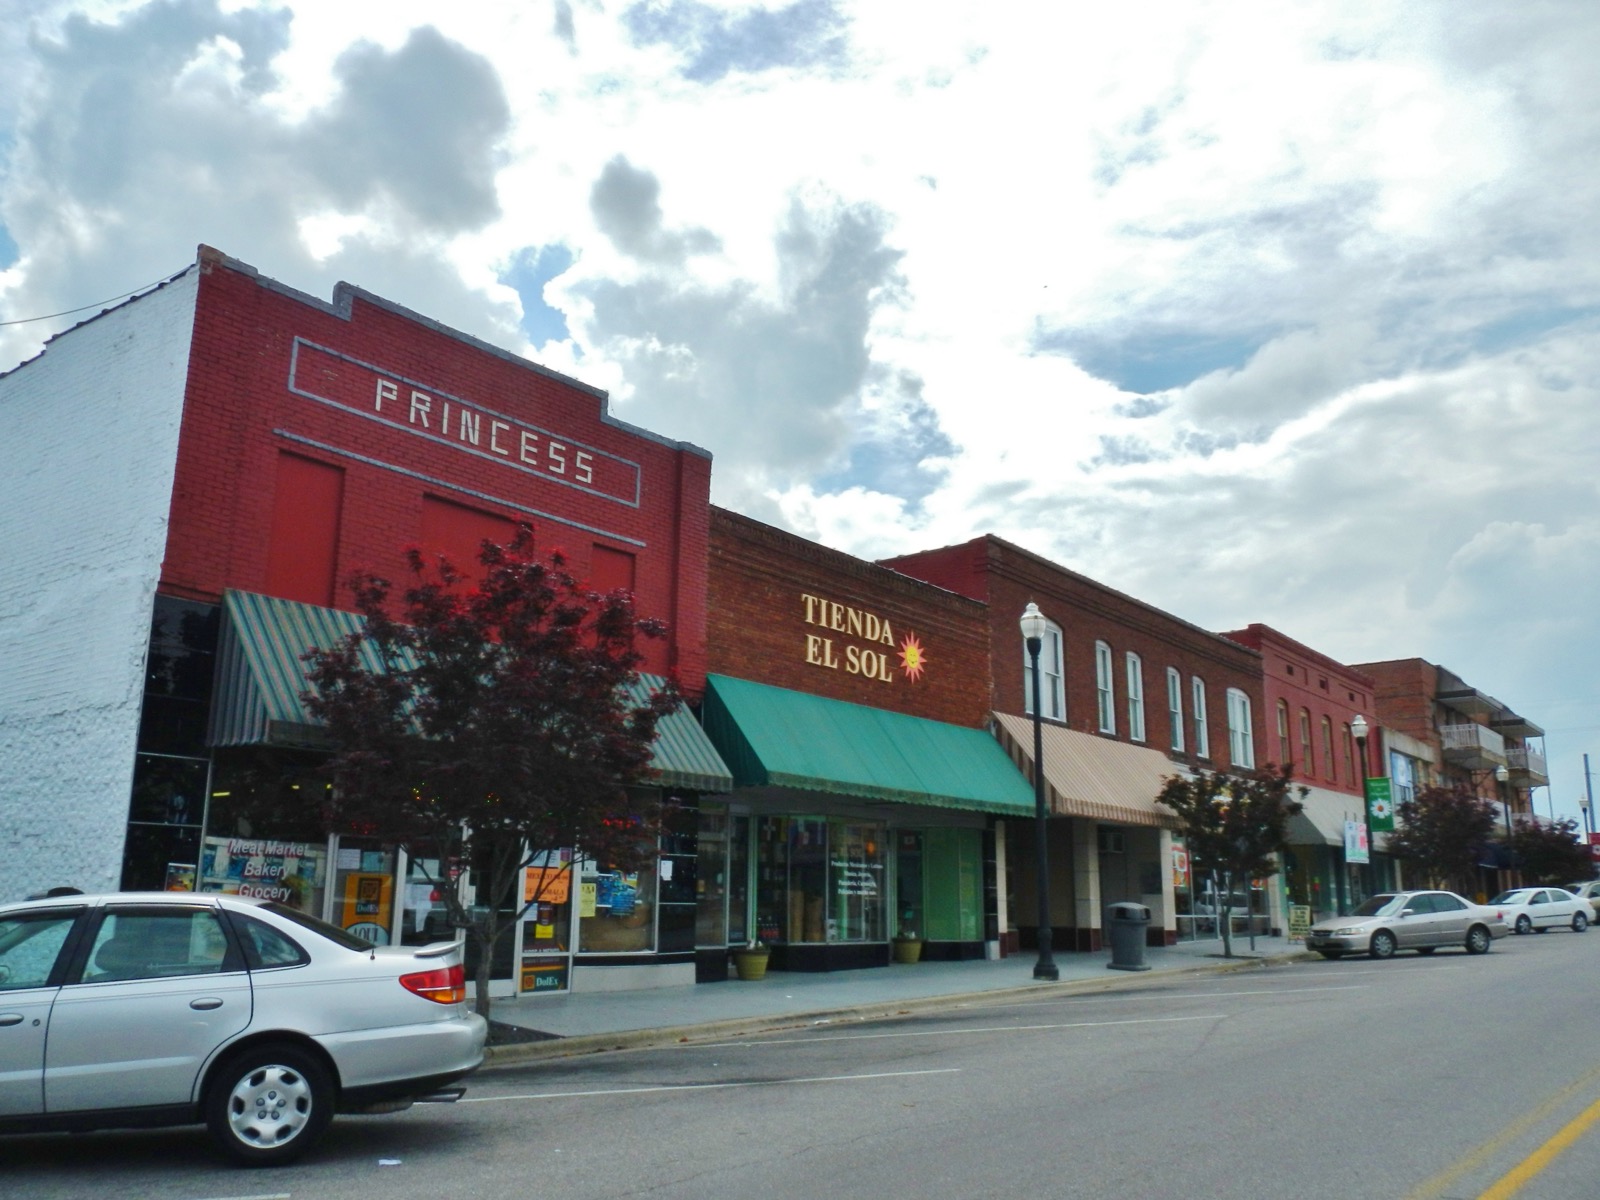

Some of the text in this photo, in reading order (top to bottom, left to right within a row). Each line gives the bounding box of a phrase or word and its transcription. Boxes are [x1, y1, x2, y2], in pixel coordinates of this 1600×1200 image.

[375, 378, 593, 484] PRINCESS
[801, 593, 896, 647] TIENDA
[805, 633, 893, 683] EL SOL
[228, 839, 309, 857] Meat Market
[243, 861, 290, 880] Bakery
[239, 884, 291, 902] Grocery
[536, 976, 559, 987] DolEx
